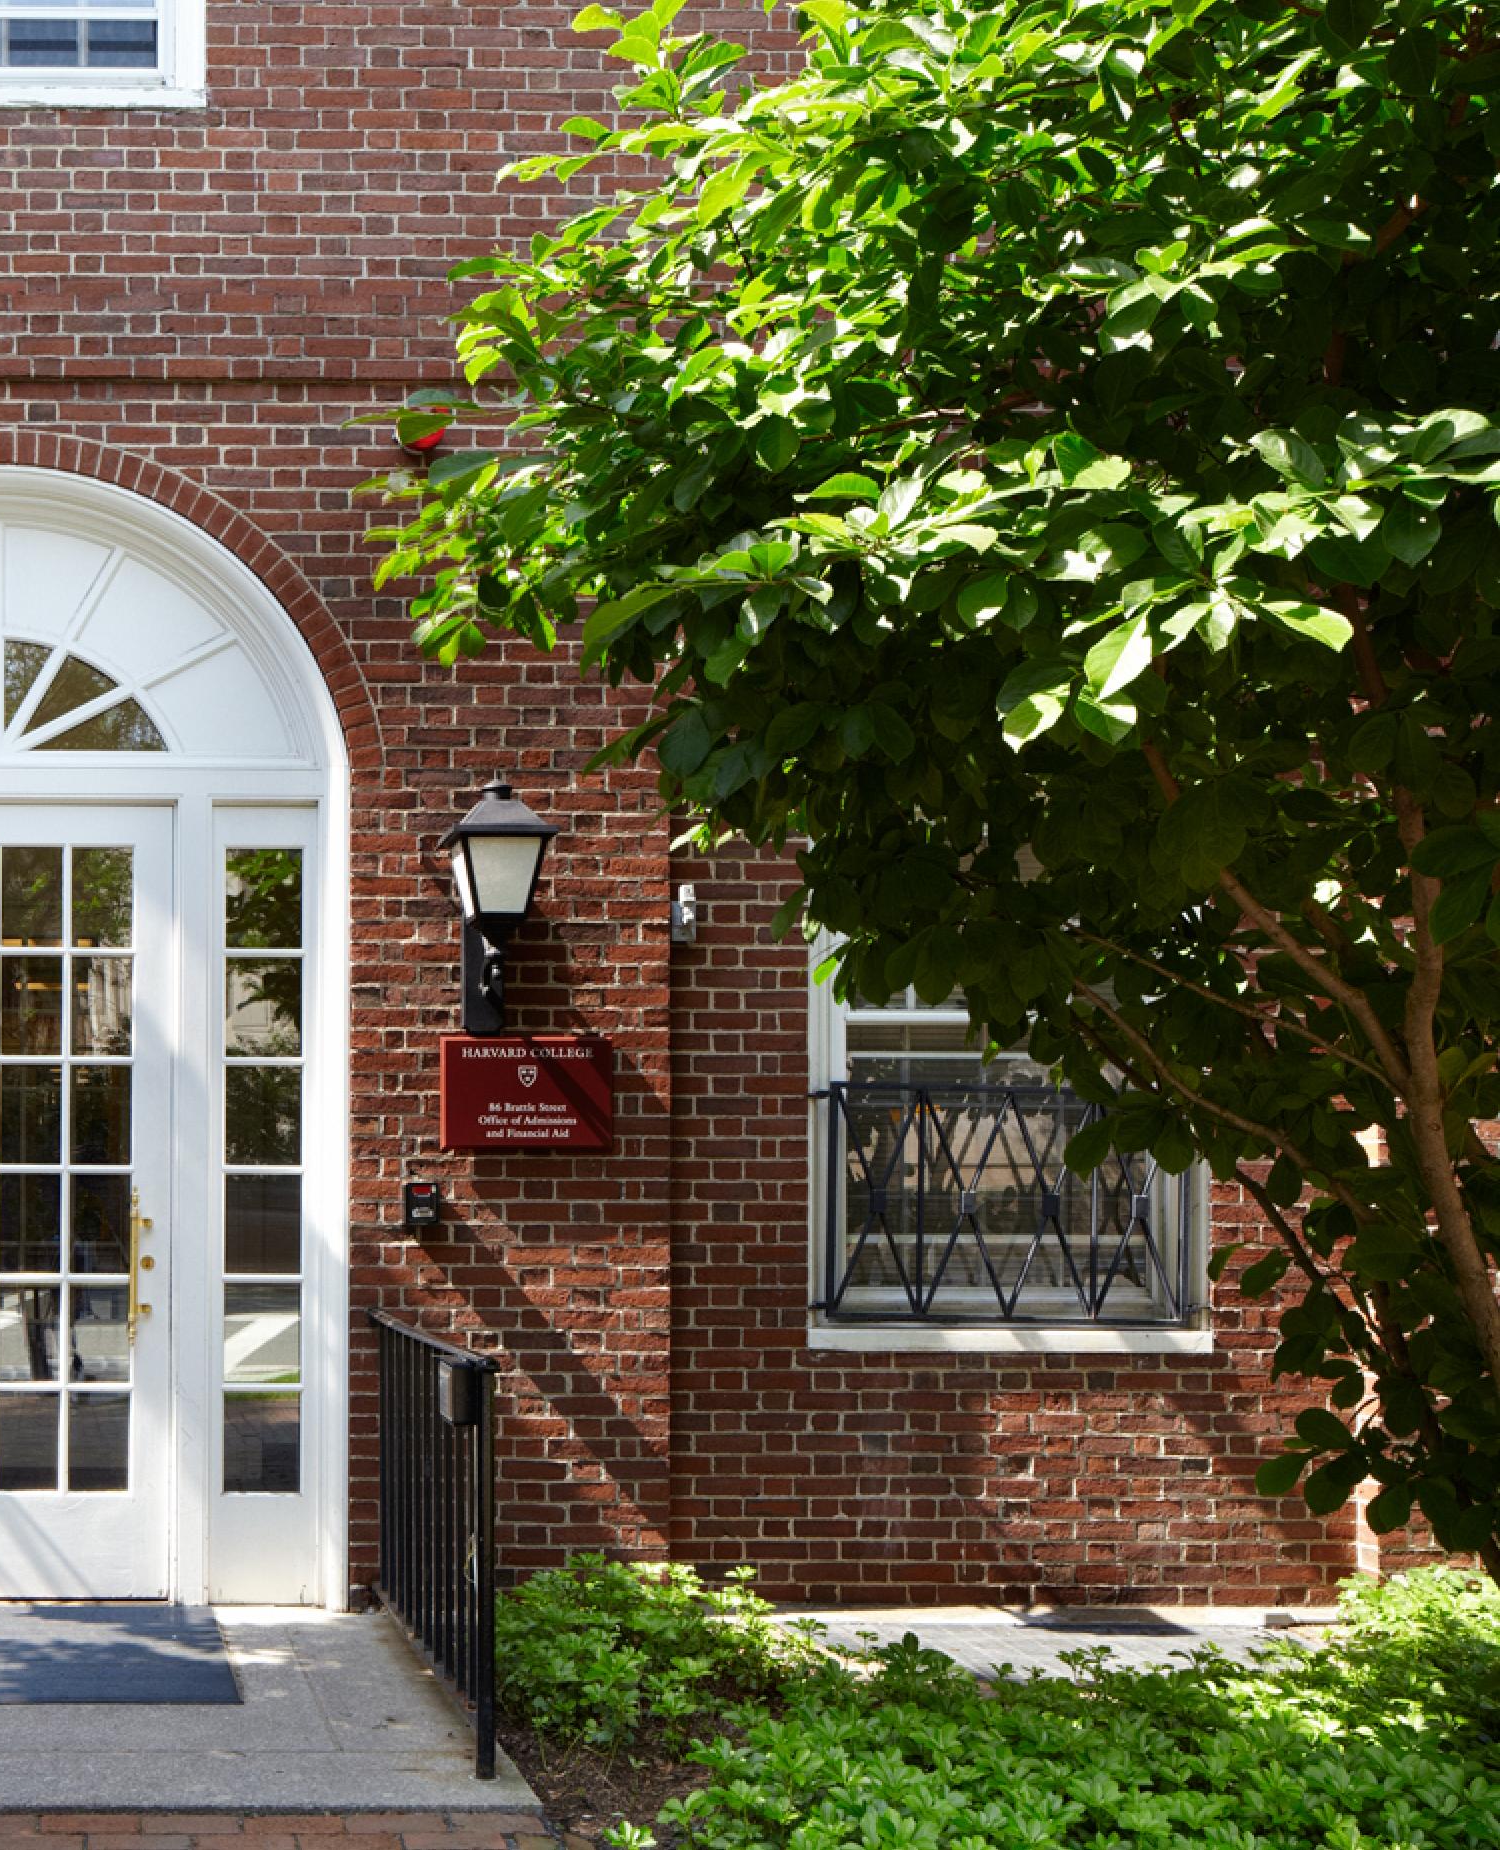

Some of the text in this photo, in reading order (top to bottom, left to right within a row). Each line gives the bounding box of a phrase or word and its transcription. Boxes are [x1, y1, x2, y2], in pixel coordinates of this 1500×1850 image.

[461, 1047, 594, 1058] HARVARD COLLEGE
[503, 1102, 536, 1112] Brattle
[538, 1102, 567, 1112] Street
[477, 1115, 577, 1125] Office of Admissions
[485, 1128, 570, 1138] and Financial Aid
